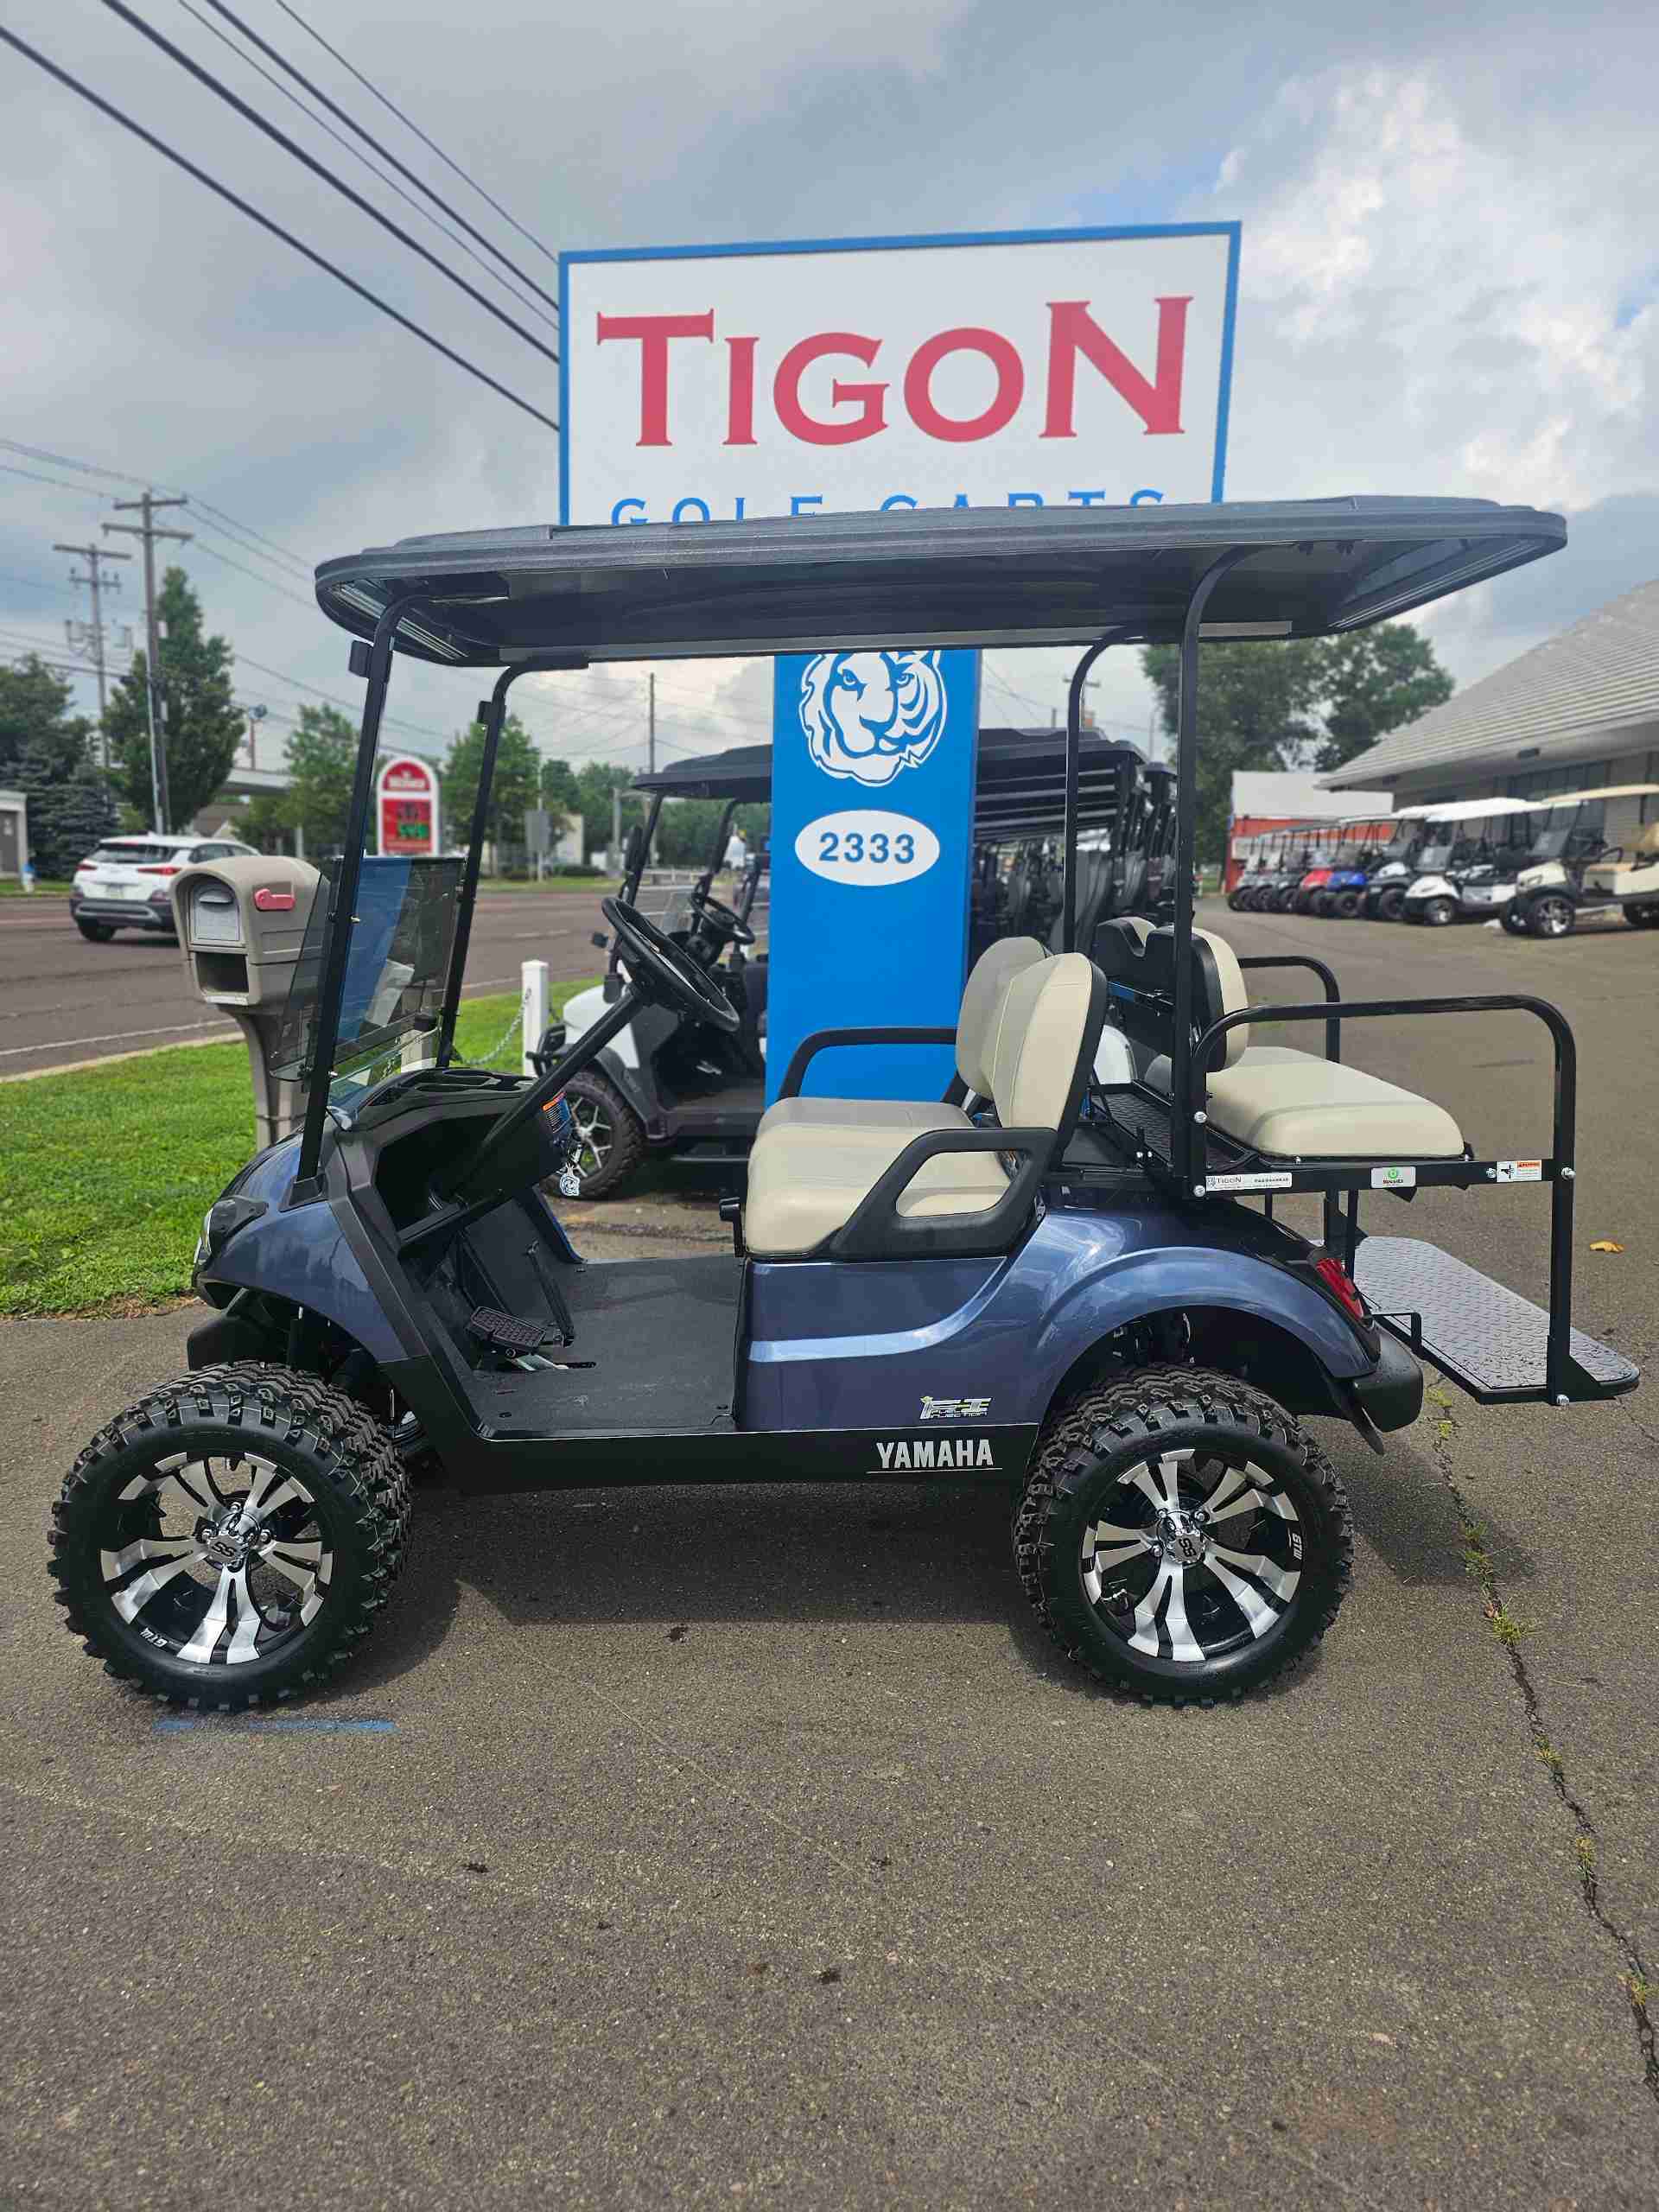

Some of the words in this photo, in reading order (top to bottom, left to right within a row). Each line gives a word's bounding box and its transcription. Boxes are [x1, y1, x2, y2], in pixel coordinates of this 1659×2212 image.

[596, 296, 1194, 447] TIGON
[818, 831, 915, 864] 2333
[876, 1439, 994, 1469] YAMAHA
